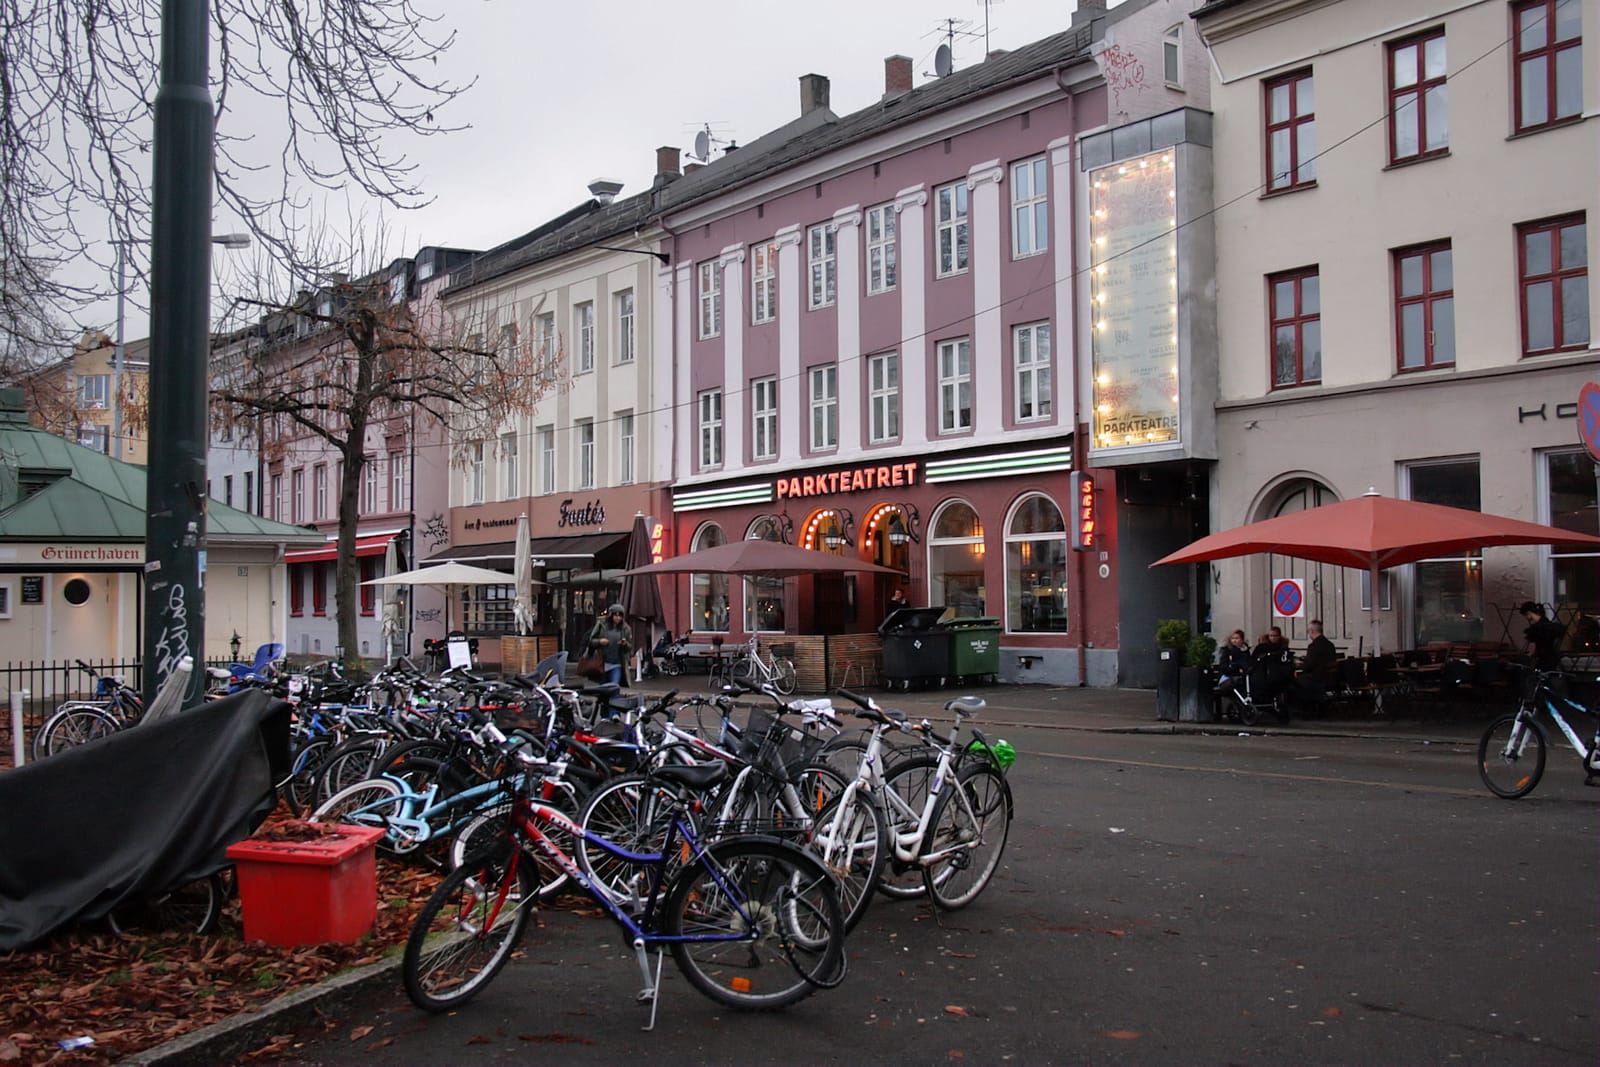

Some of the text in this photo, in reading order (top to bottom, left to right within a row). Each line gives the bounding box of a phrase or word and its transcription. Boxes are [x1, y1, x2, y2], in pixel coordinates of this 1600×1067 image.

[776, 462, 917, 499] PARKTEATRET
[559, 498, 605, 528] Fontés
[1082, 480, 1094, 546] SCENE
[41, 545, 139, 561] Grünerhaven
